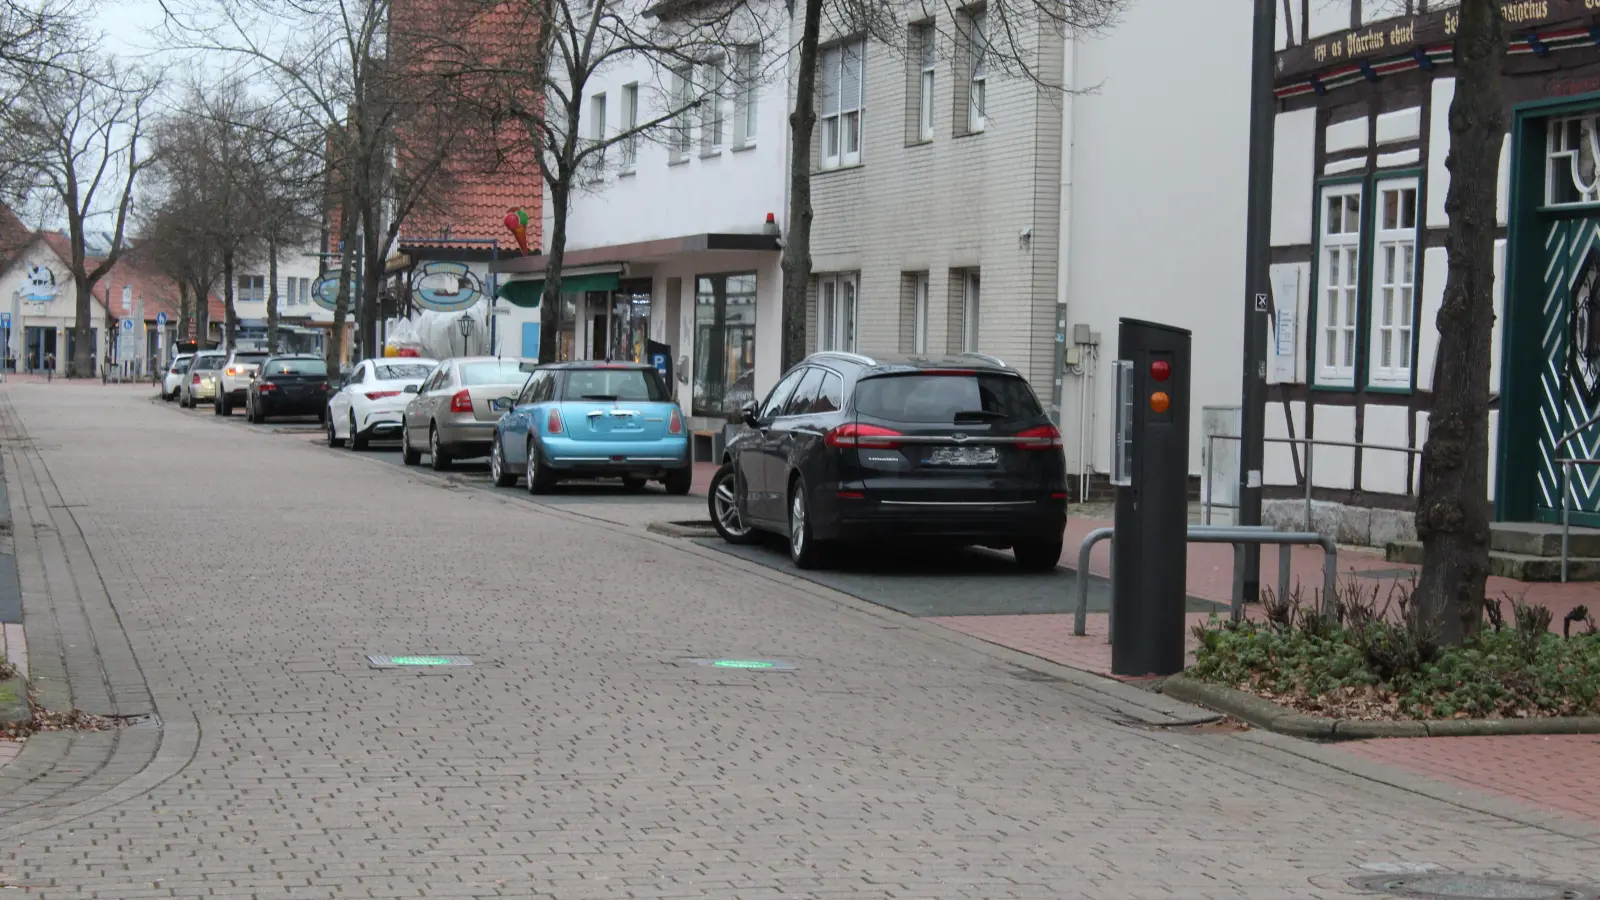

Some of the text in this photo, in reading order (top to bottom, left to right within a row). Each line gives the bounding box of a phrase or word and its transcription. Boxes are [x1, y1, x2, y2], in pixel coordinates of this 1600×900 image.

[1331, 40, 1342, 57] as
[1346, 29, 1385, 58] Pfarrhus
[655, 355, 665, 368] P
